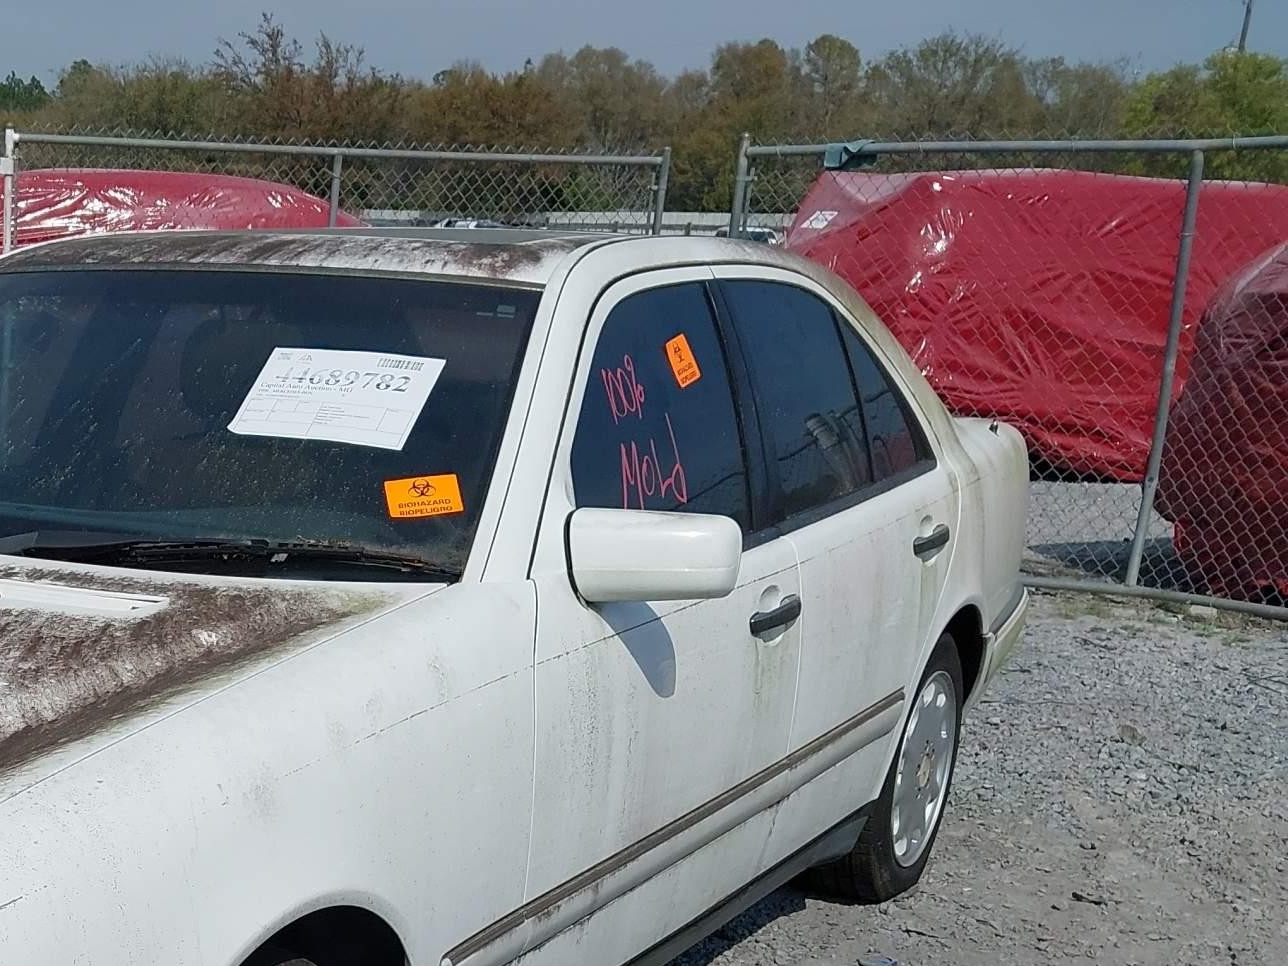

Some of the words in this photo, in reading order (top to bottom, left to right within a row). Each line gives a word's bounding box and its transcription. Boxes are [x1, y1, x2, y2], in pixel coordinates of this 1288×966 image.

[274, 366, 412, 393] 44689782
[600, 353, 646, 425] 100%
[398, 498, 452, 509] BIOHAZARD
[399, 506, 453, 516] BIOPELIGRO
